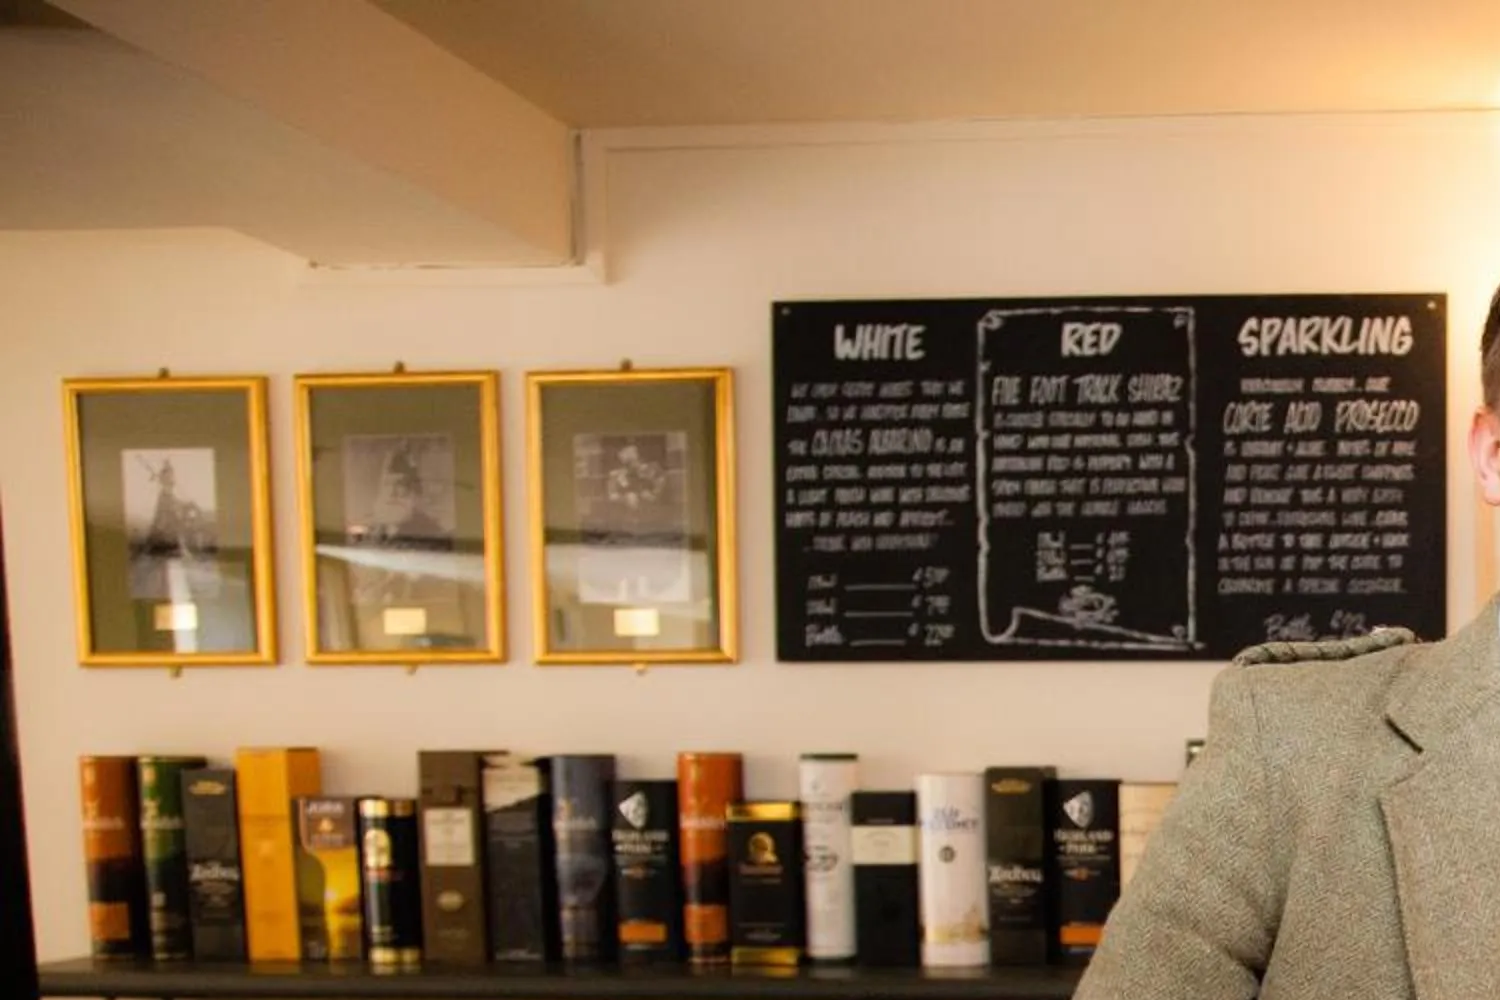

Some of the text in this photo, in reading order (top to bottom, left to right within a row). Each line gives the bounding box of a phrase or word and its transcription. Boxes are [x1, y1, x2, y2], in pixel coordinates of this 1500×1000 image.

[834, 323, 926, 361] WHITE
[1061, 322, 1123, 357] RED
[1237, 316, 1414, 356] SPARKLING
[1333, 398, 1421, 435] PROSECCO
